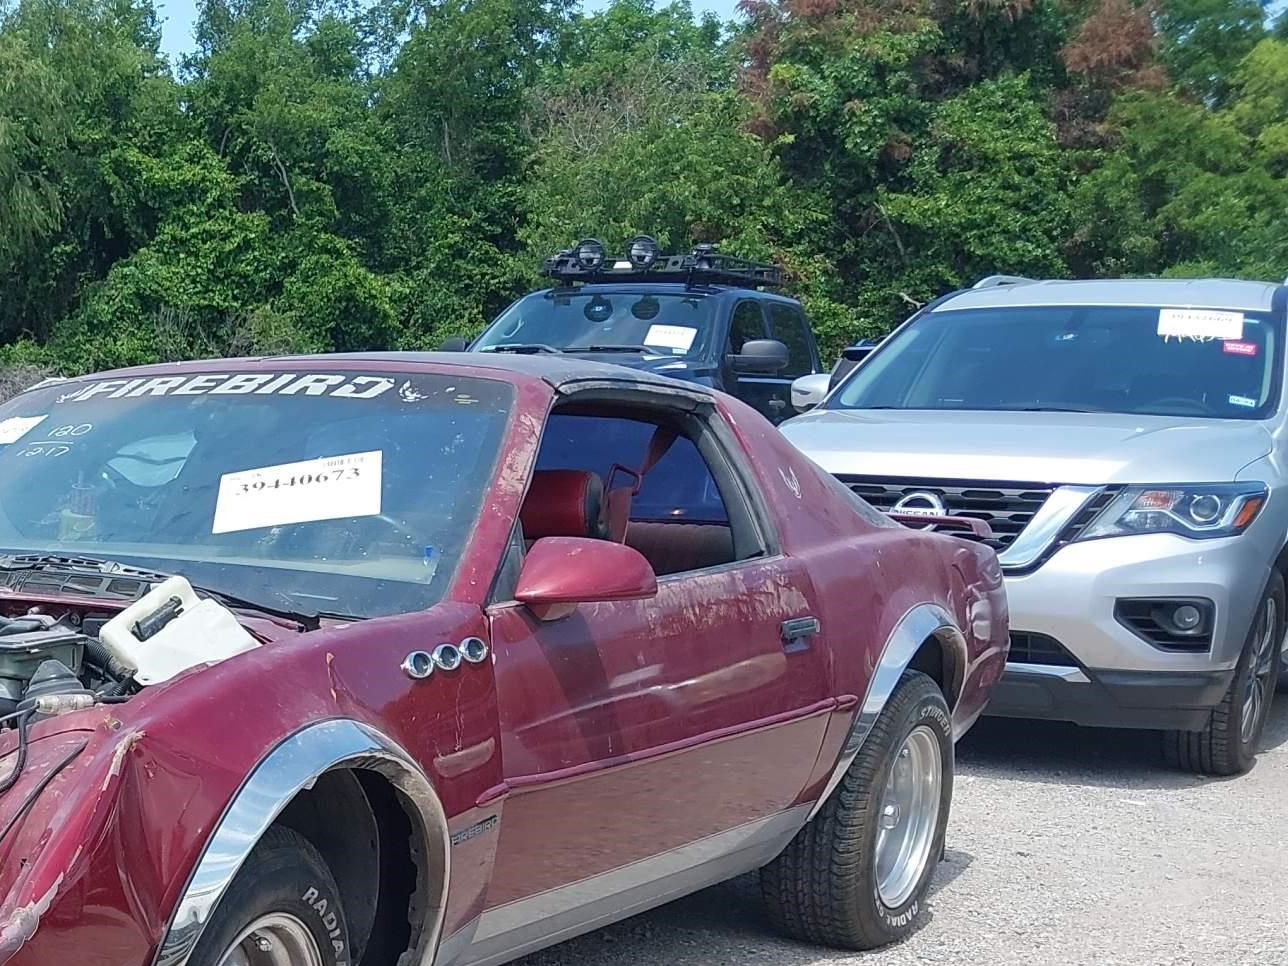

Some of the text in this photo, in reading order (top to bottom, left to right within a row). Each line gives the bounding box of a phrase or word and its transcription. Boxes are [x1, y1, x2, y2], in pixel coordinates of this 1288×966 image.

[73, 372, 395, 402] FIREBIRD
[235, 467, 362, 497] 39440673
[919, 705, 951, 736] STINGER
[886, 900, 918, 927] RADIAL
